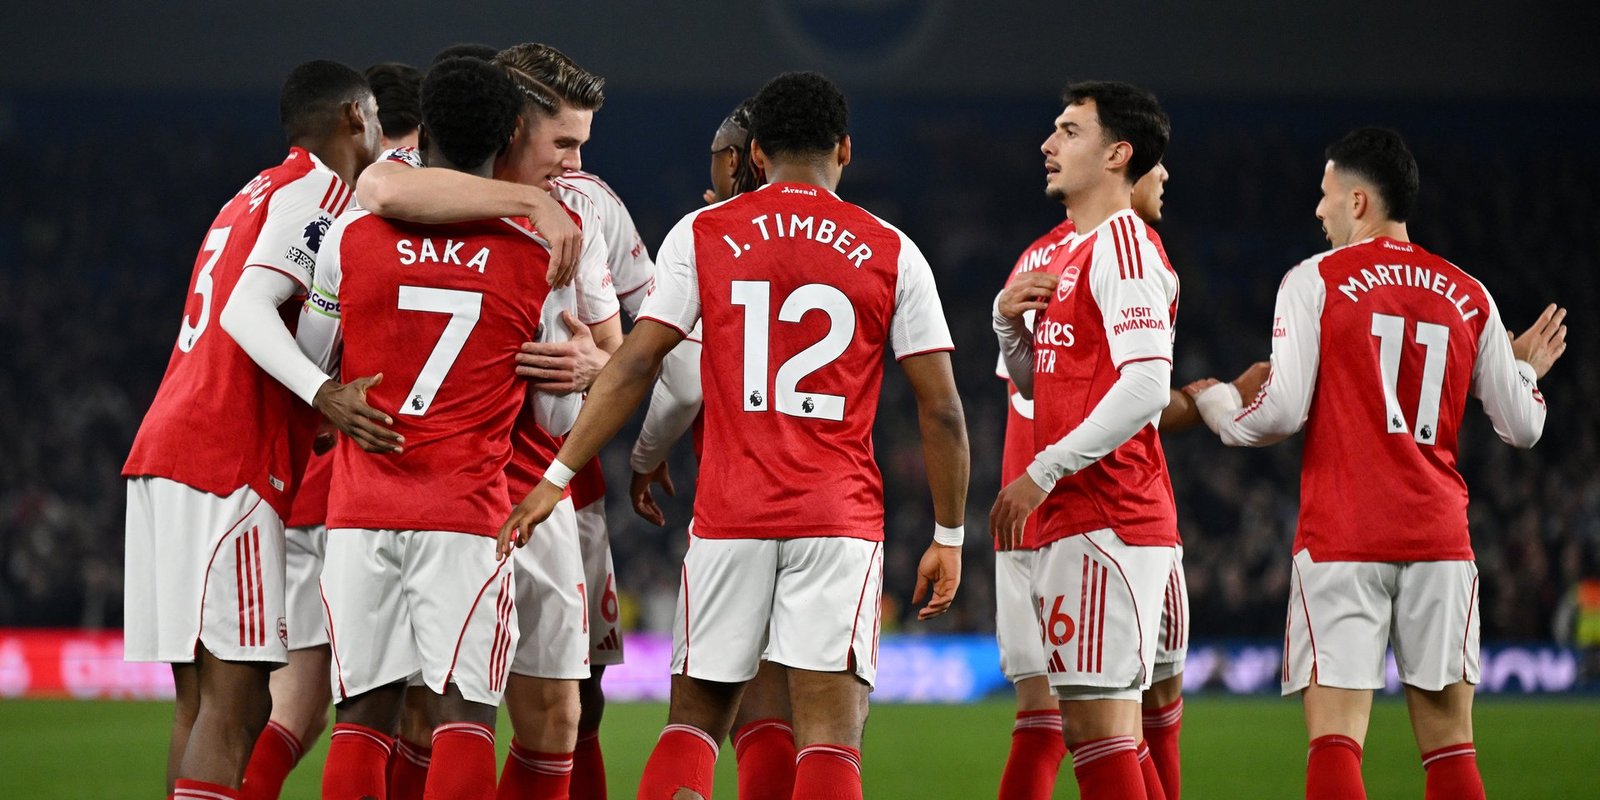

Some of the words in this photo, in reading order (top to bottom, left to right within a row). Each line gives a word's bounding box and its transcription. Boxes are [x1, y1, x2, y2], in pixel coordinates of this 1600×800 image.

[396, 238, 490, 274] SAKA
[722, 234, 751, 259] J.
[751, 213, 873, 269] TIMBER
[177, 225, 233, 354] 3
[1121, 306, 1151, 319] VISIT
[1338, 264, 1479, 323] MARTINELLI
[397, 285, 484, 416] 7
[730, 280, 856, 421] 12
[1113, 319, 1165, 336] RWANDA
[1370, 312, 1450, 446] 11
